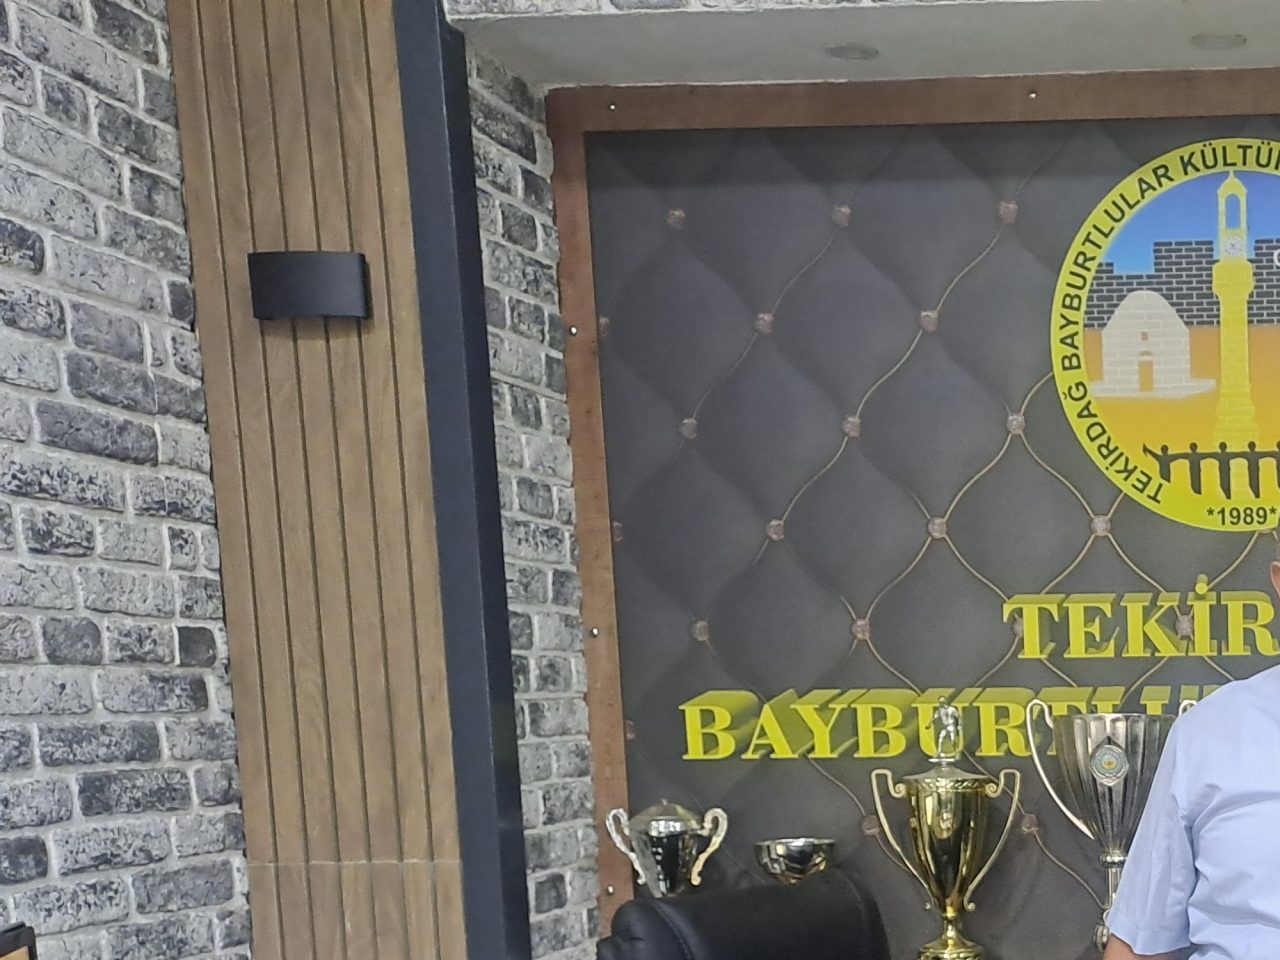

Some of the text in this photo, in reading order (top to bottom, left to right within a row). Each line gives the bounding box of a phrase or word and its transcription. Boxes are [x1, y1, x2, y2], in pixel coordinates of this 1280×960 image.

[1059, 164, 1175, 372] BAYBURTLULAR
[1062, 380, 1164, 504] TEKİRDAĞ
[679, 687, 1202, 760] BAYBUR
